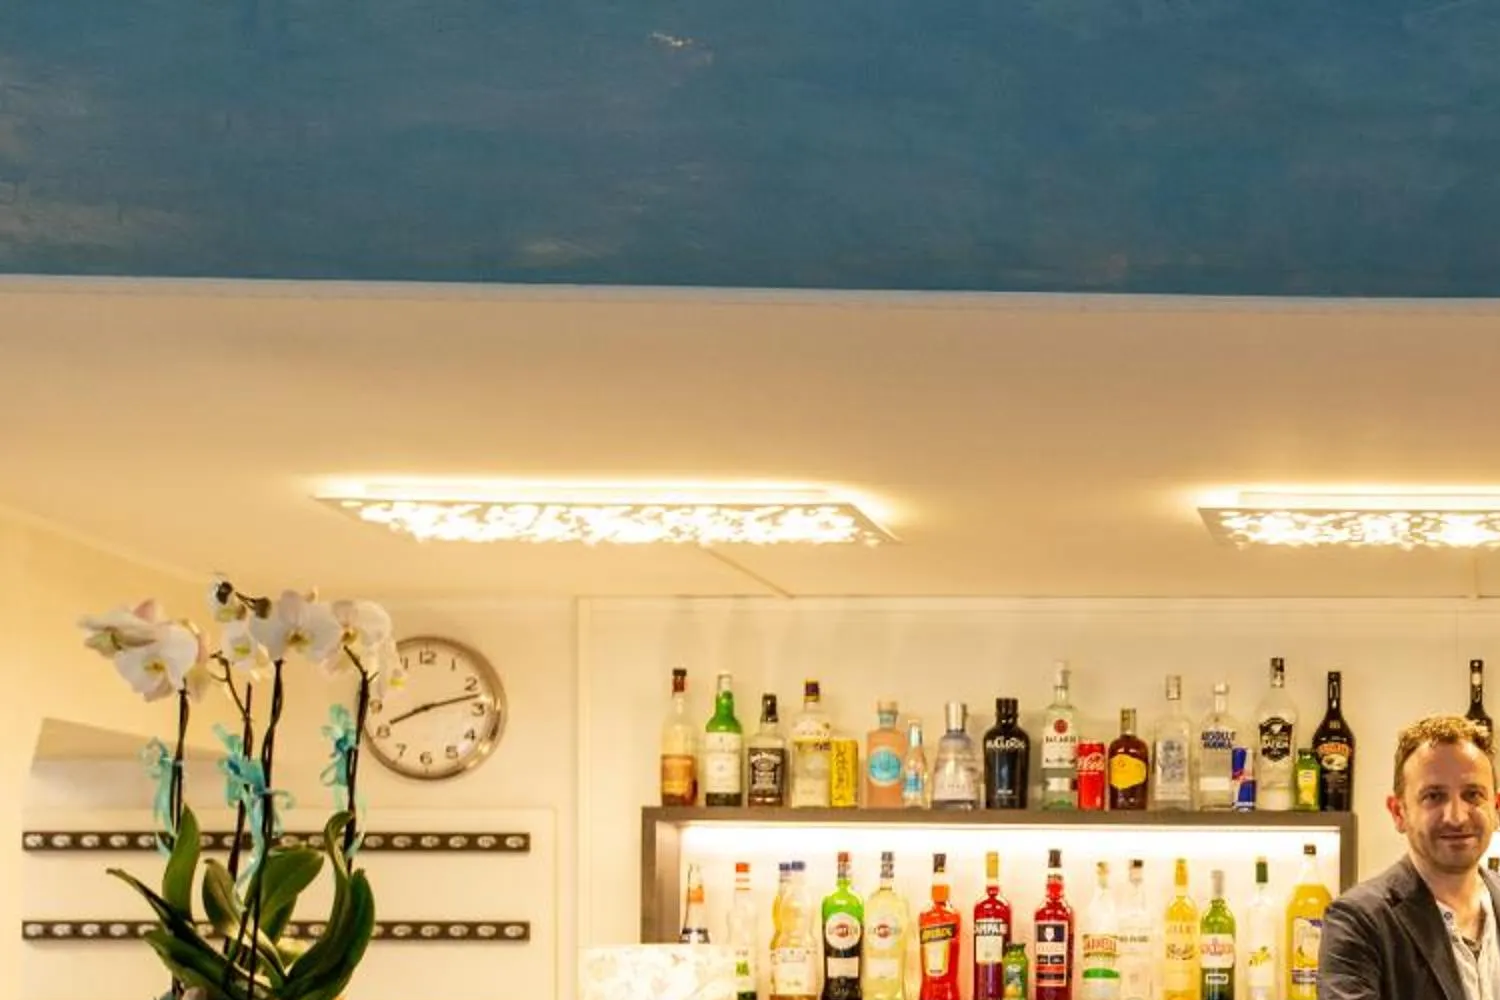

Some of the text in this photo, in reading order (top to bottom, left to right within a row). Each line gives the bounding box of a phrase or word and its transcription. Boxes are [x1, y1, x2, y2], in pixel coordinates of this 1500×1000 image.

[419, 650, 437, 664] 12
[464, 676, 478, 691] 2
[472, 702, 485, 716] 3
[376, 725, 390, 738] 8
[464, 728, 476, 741] 4
[396, 743, 407, 757] 7
[446, 745, 458, 759] 5
[419, 751, 432, 765] 6
